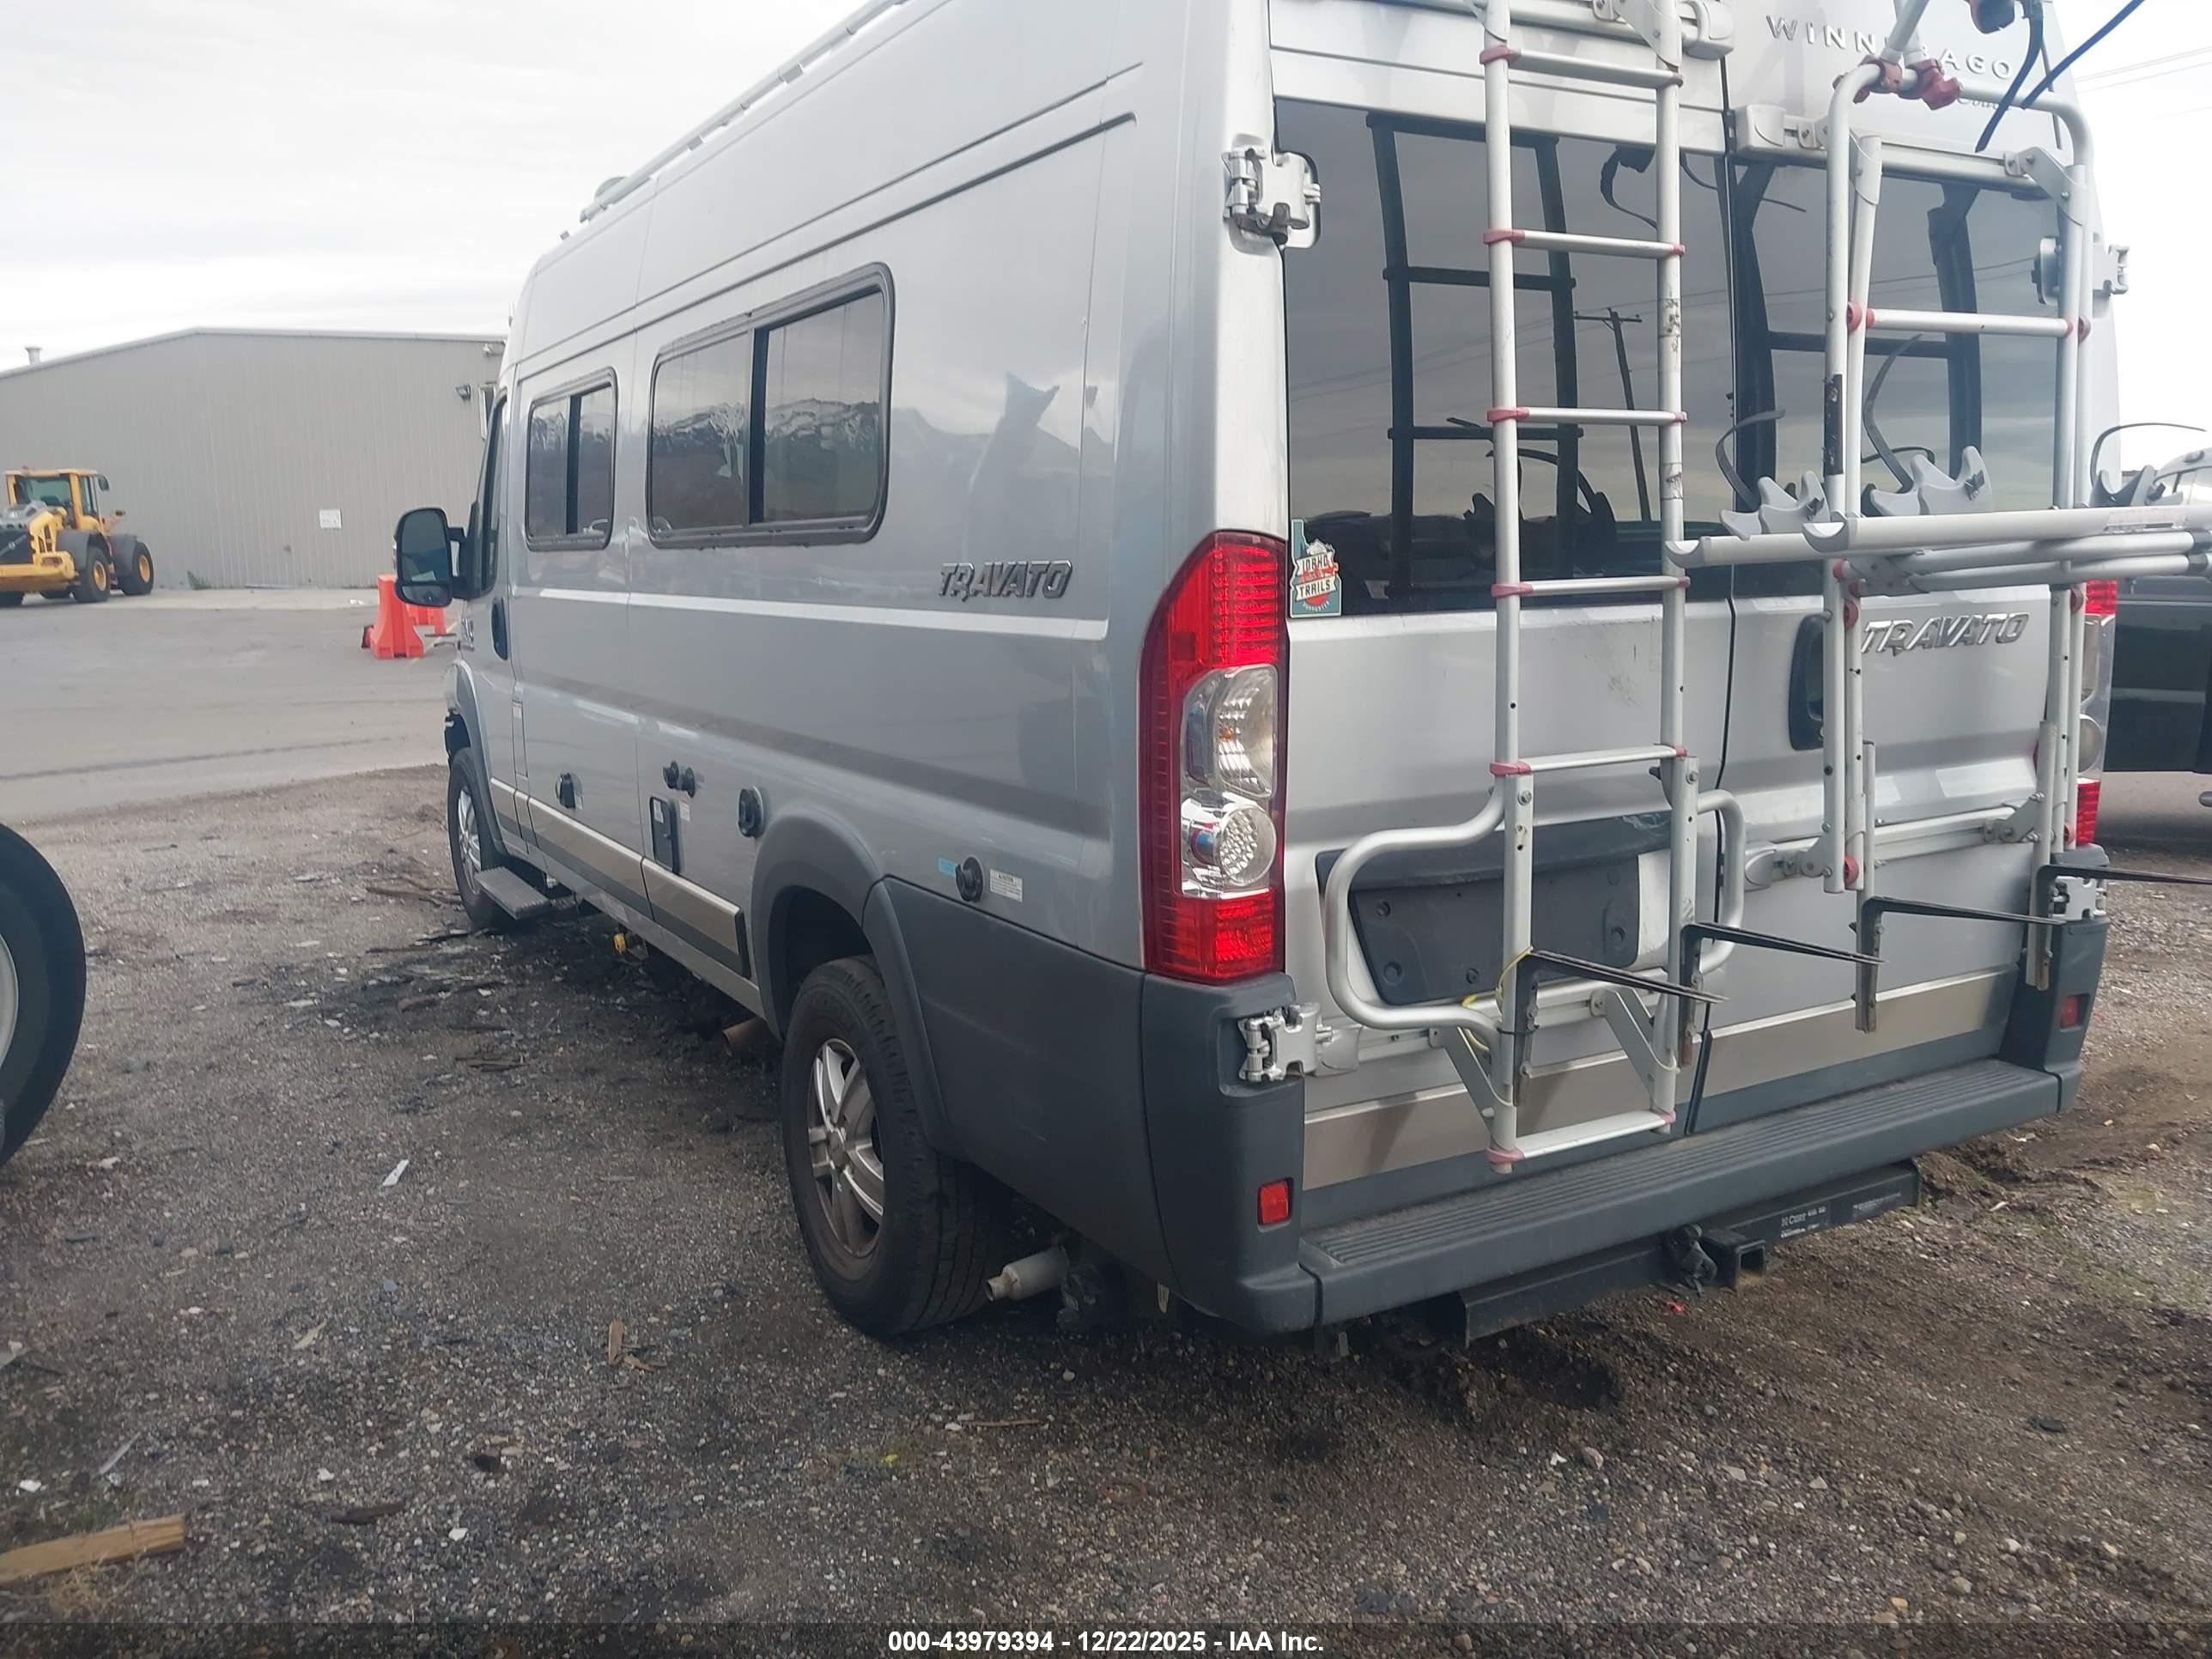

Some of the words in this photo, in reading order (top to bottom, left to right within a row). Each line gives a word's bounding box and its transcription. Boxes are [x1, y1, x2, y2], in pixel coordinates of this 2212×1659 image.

[1766, 15, 2013, 78] WINNAGO
[939, 560, 1073, 602] TRAVATO
[1299, 580, 1330, 598] TRAILS
[1861, 612, 2030, 655] TRAVATO
